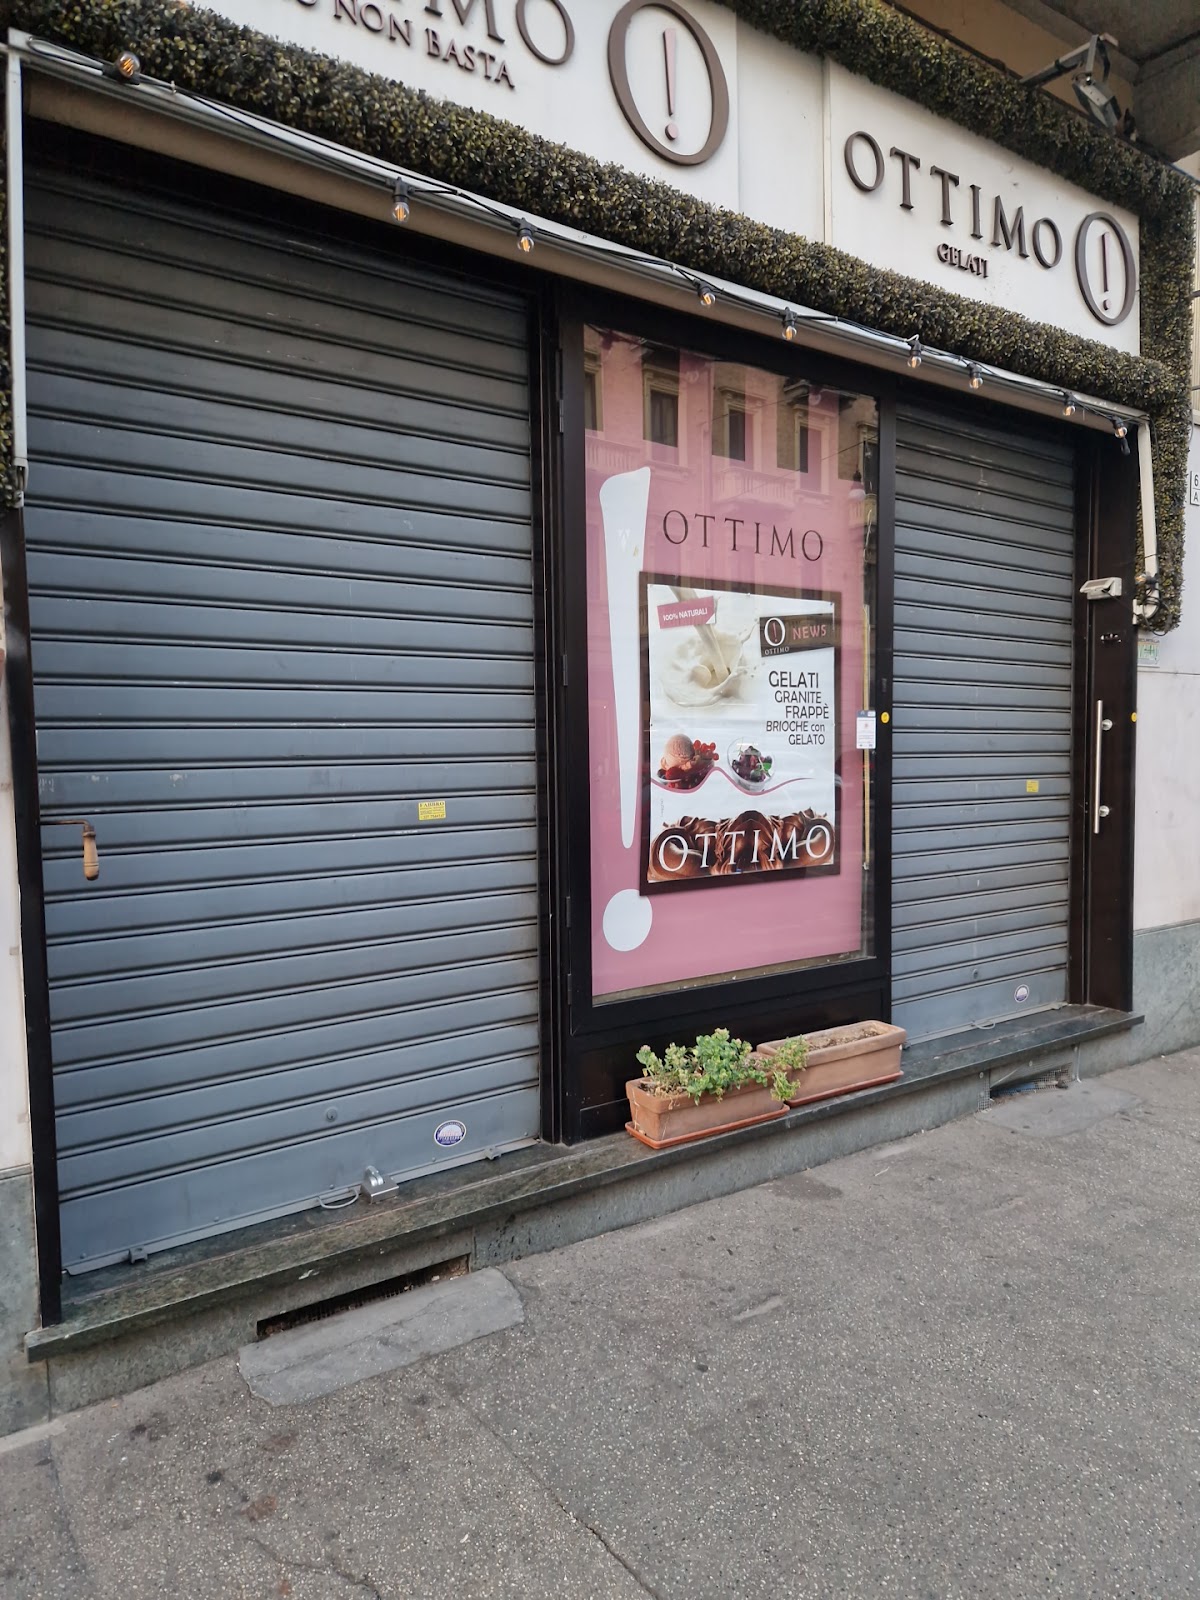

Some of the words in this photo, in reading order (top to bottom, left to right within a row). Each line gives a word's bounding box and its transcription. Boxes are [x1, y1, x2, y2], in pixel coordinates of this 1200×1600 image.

[334, 0, 411, 47] NON
[425, 28, 515, 90] BASTA
[844, 131, 1062, 268] OTTIMO
[936, 243, 989, 279] GELATI
[663, 510, 823, 562] OTTIMO
[662, 613, 678, 622] 100%
[678, 607, 708, 619] NATURALI
[792, 624, 827, 640] NEWS
[764, 646, 790, 656] OTTIMO
[768, 670, 819, 689] GELATI
[774, 690, 822, 704] GRANITE
[785, 703, 829, 719] FRAPPÈ
[766, 720, 809, 732] BRIOCHE
[810, 724, 825, 732] con
[788, 734, 825, 745] GELATO
[658, 825, 831, 872] OTTIMO
